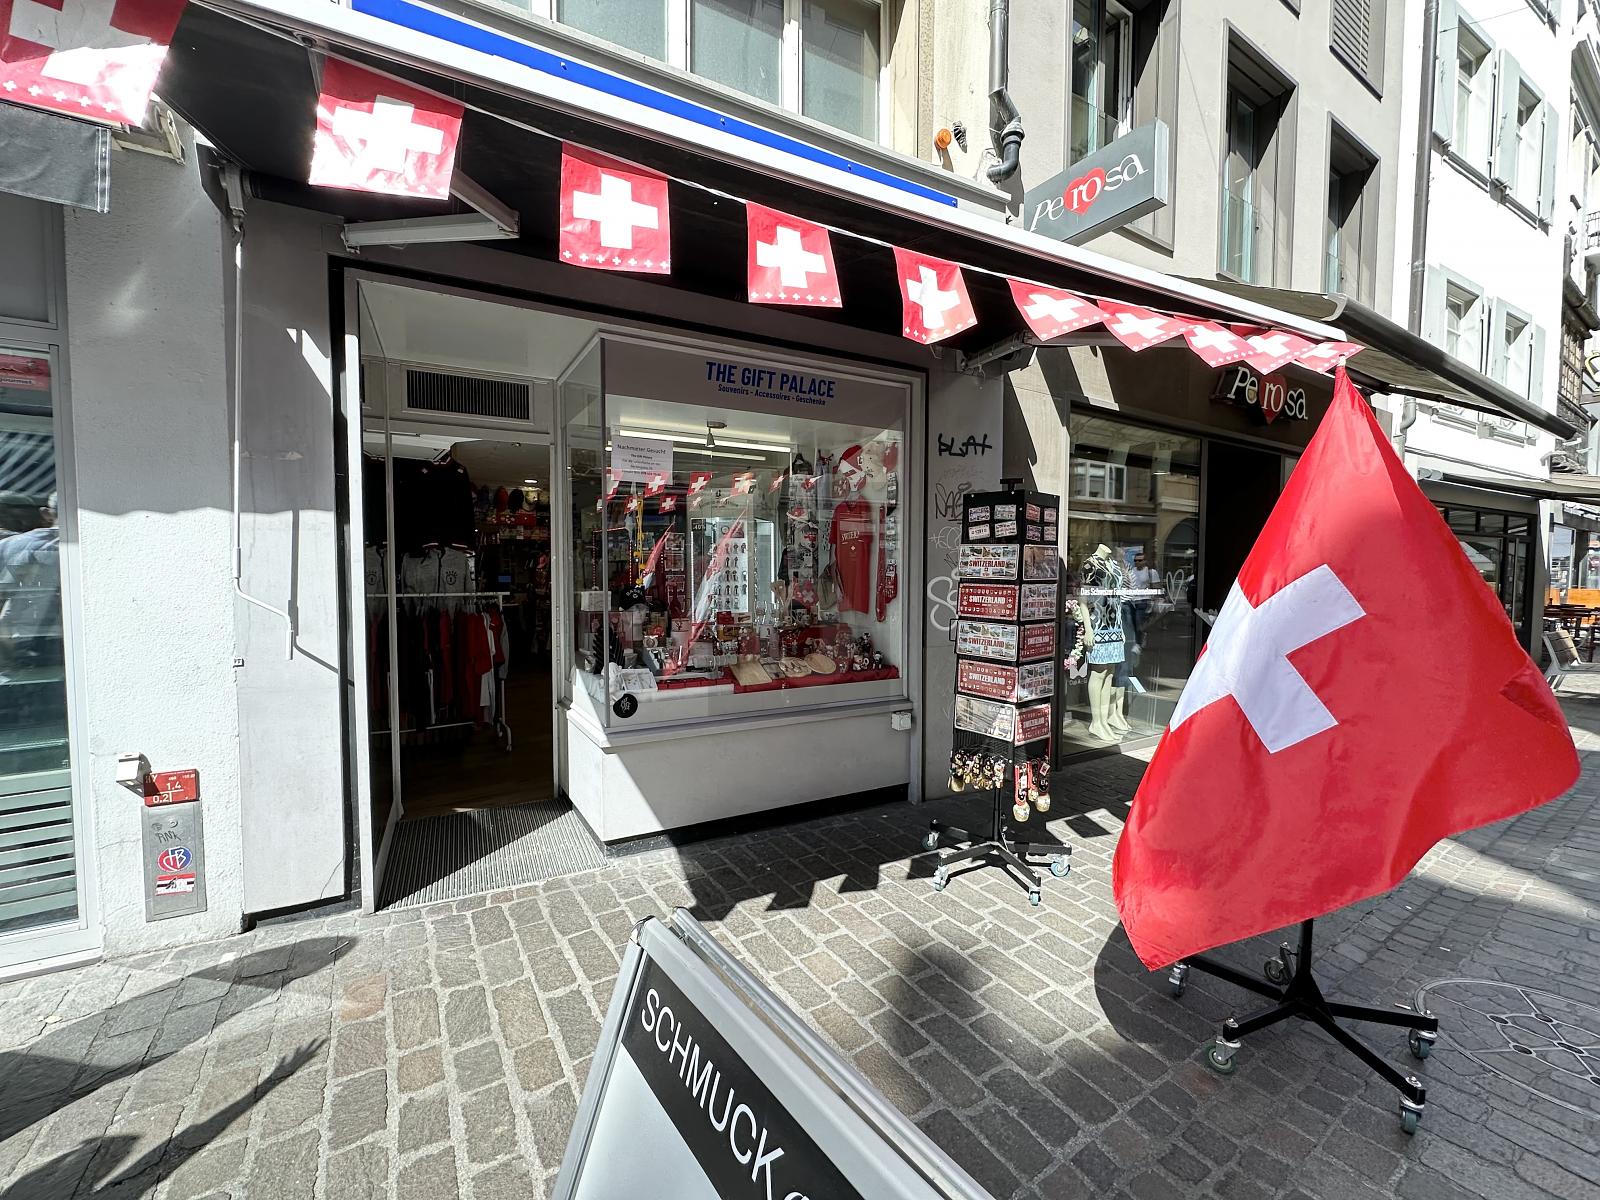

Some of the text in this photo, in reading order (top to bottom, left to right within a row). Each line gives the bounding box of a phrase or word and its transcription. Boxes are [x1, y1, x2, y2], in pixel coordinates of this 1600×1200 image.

[706, 361, 835, 398] THE GIFT PALACE
[718, 384, 749, 395] Souvenirs
[754, 389, 790, 401] Accessoires
[796, 394, 826, 405] Geschenke
[969, 560, 1006, 568] SWITZERLAND
[969, 595, 1006, 604] SWITZERLAND
[968, 637, 1005, 648] SWITZERLAND
[968, 672, 1006, 685] SWITZERLAND
[166, 781, 182, 790] 1.4
[153, 794, 169, 803] 0.2
[641, 988, 784, 1200] SCHMUCK
